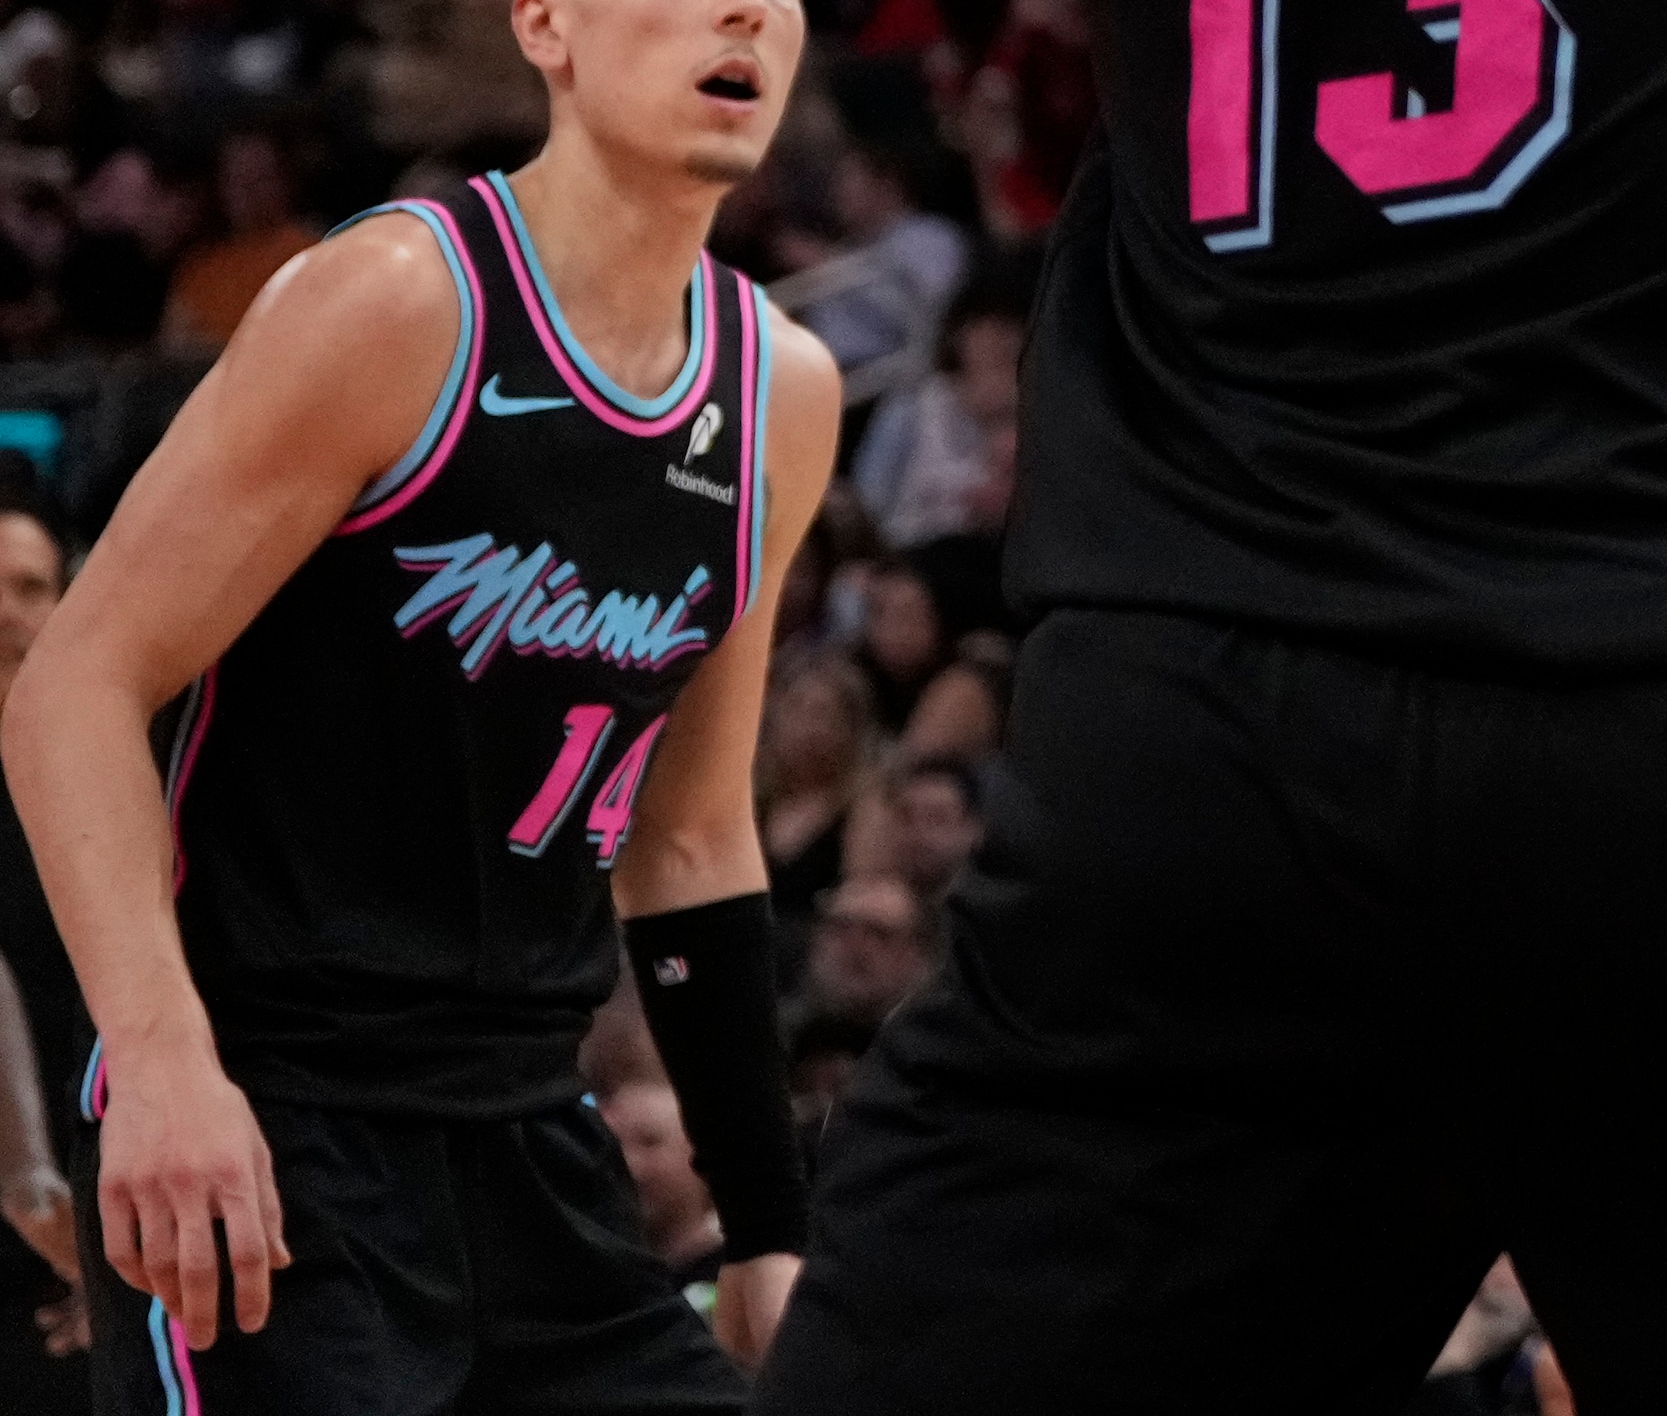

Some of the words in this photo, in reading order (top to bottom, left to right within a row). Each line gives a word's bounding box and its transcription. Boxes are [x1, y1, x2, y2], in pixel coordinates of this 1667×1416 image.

[665, 463, 736, 507] Robinhood
[394, 532, 713, 682] Miami
[507, 703, 669, 869] 14
